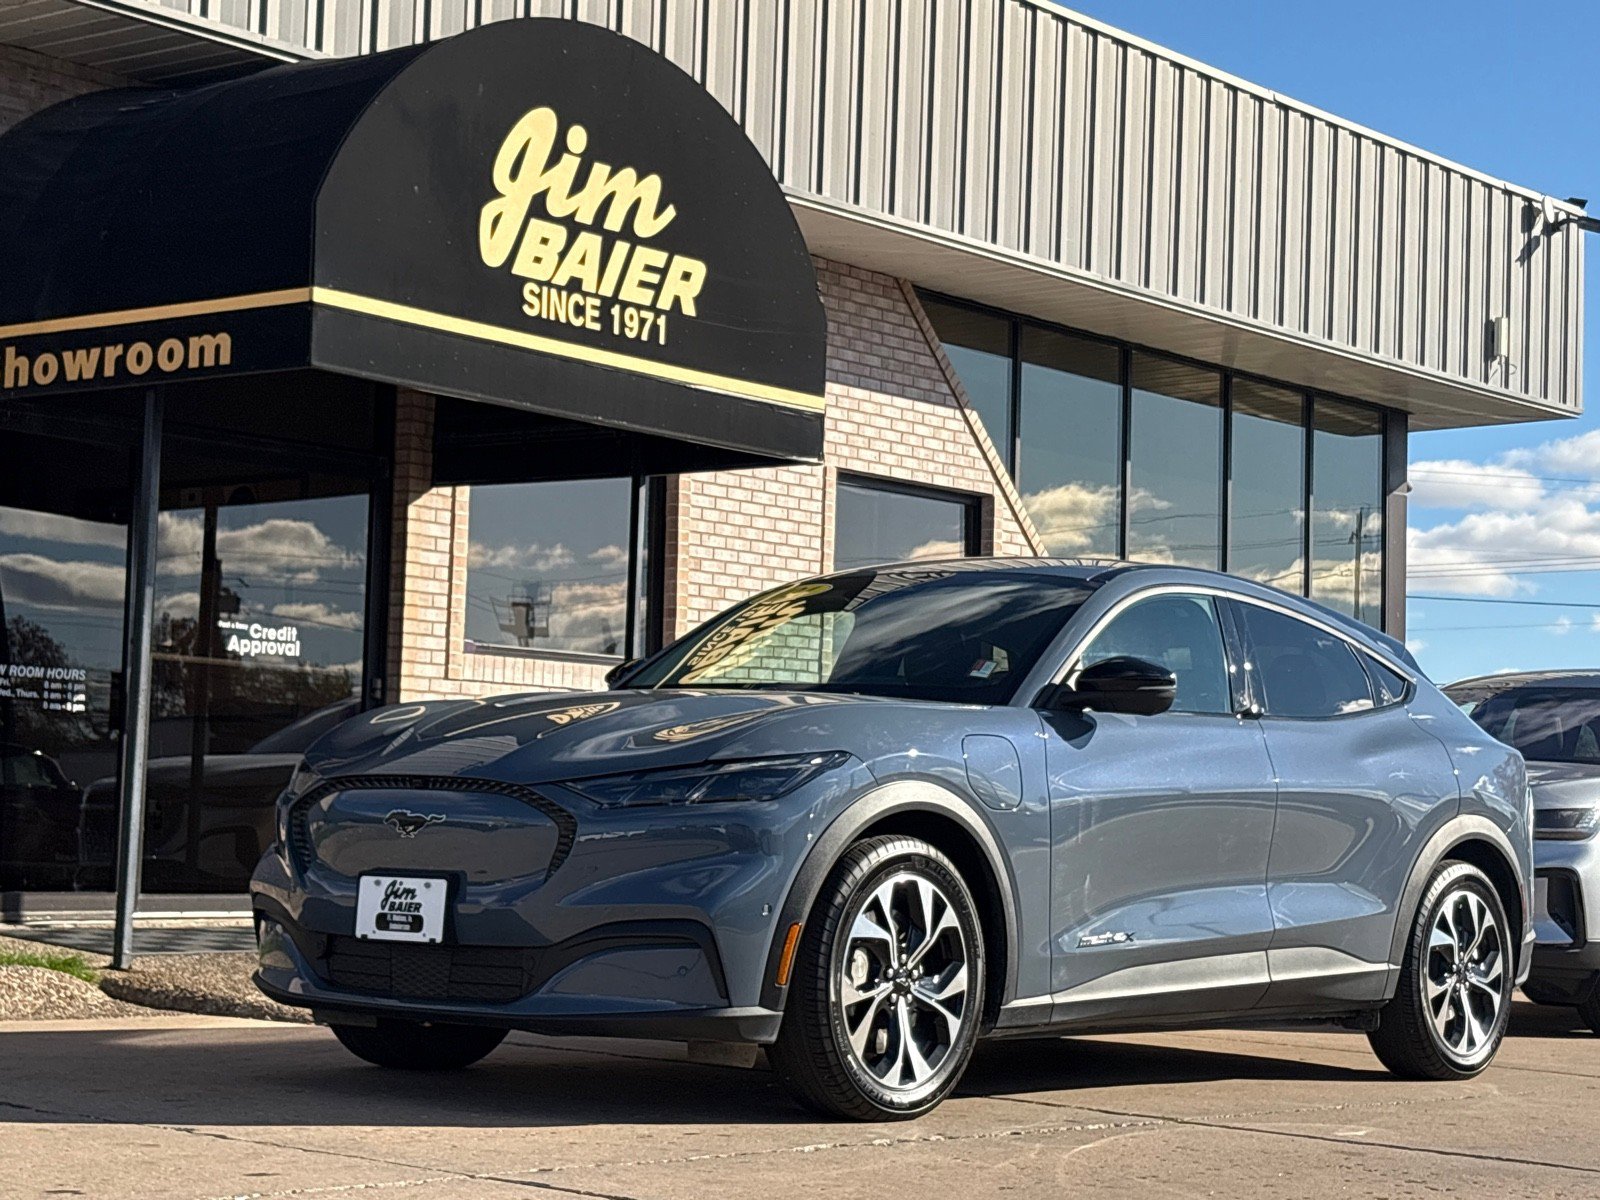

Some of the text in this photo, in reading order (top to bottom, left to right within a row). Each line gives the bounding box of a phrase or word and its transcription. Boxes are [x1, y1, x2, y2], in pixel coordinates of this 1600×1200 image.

[479, 107, 676, 268] Jim
[511, 217, 707, 317] BAIER
[522, 282, 667, 345] SINCE 1971
[249, 623, 298, 641] Credit
[227, 635, 300, 657] Approval
[9, 664, 45, 678] ROOM
[46, 668, 86, 681] HOURS
[381, 880, 418, 911] Jim
[388, 901, 422, 913] BAIER
